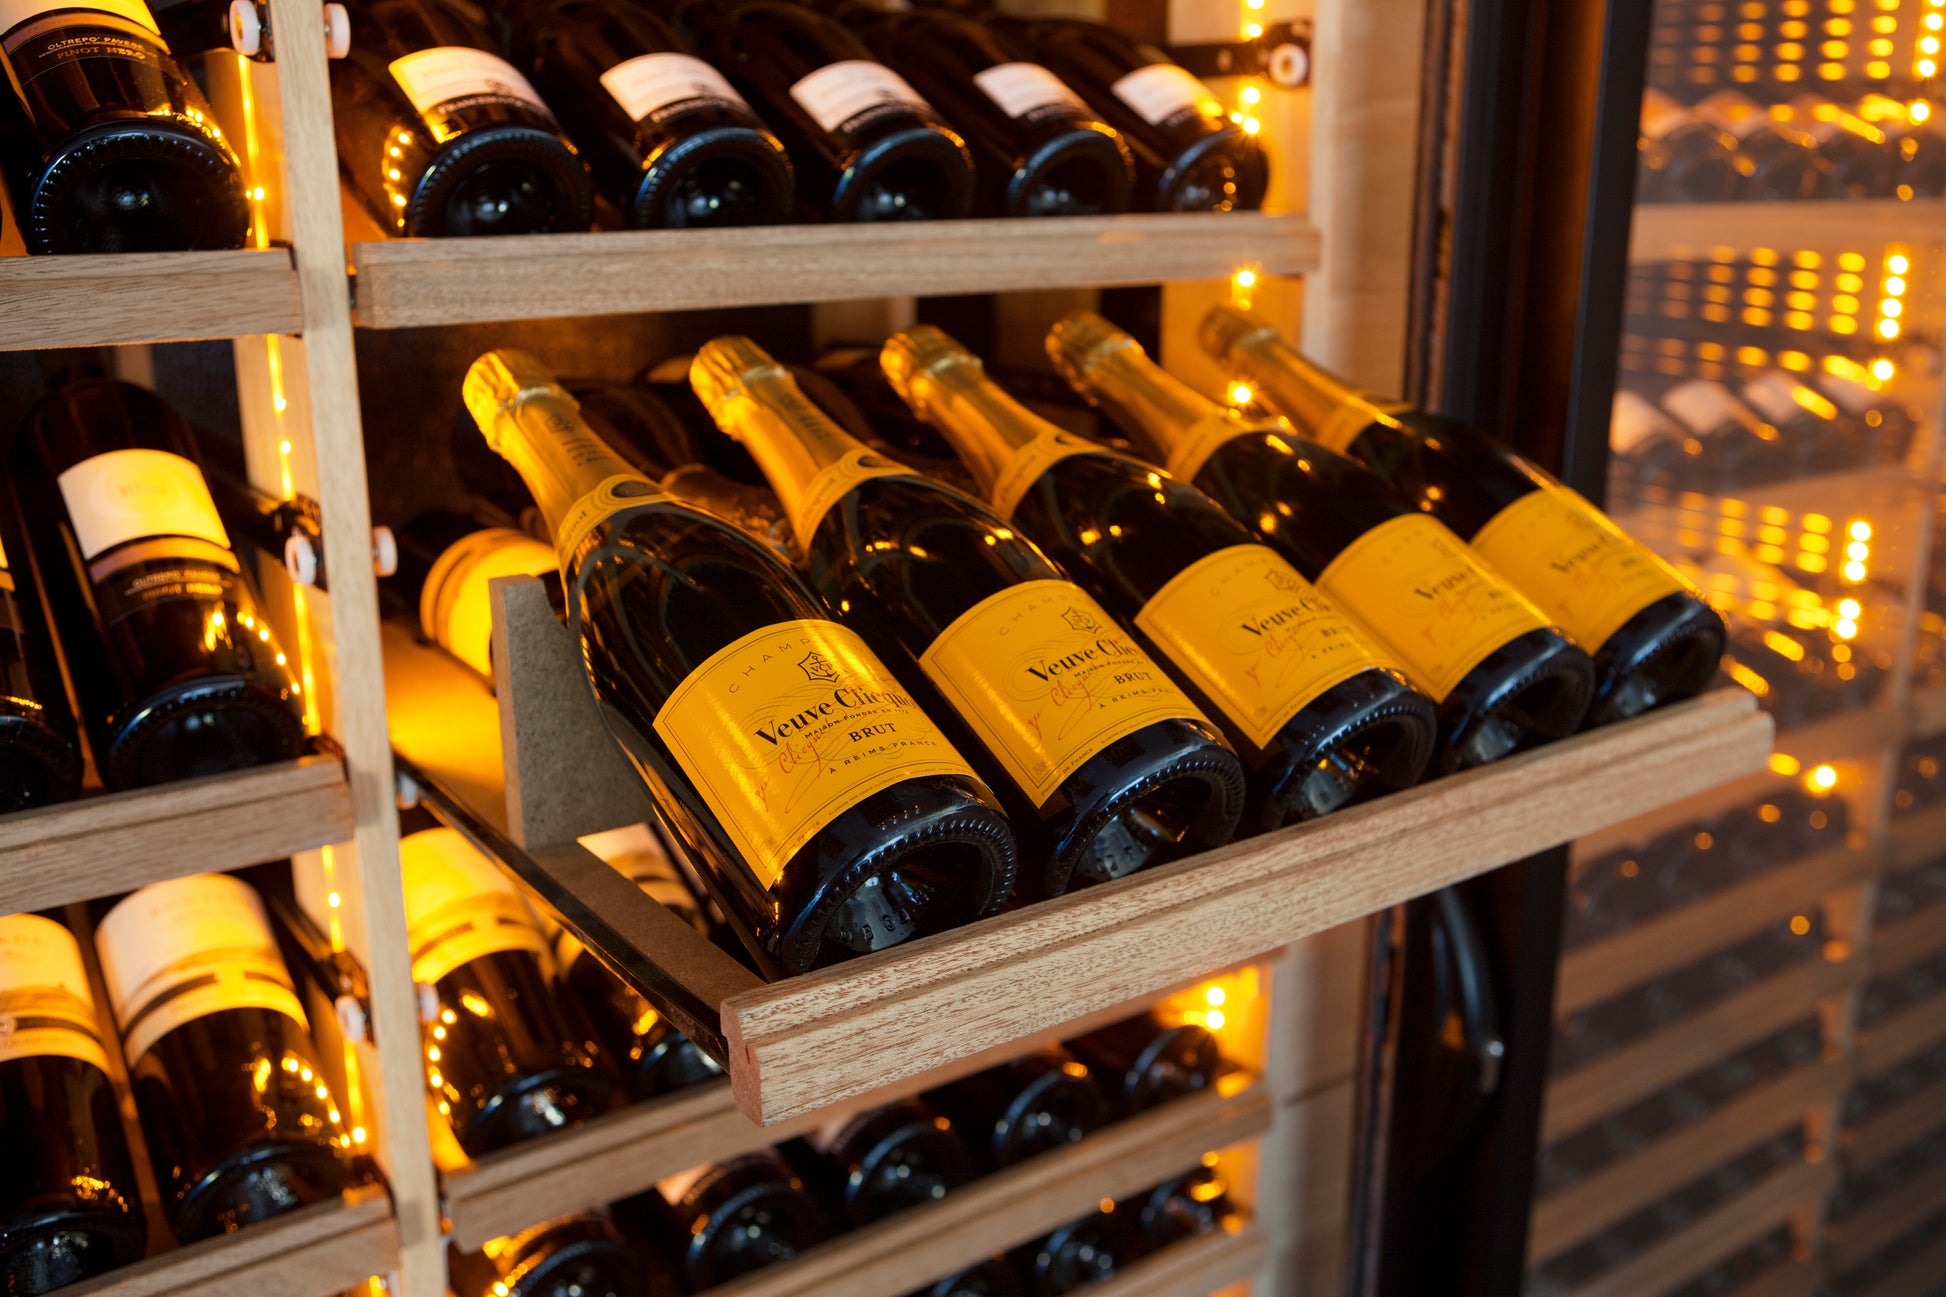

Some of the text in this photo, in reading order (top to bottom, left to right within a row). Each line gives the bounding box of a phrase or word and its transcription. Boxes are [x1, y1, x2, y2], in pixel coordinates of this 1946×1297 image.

[57, 46, 100, 59] PINOT
[106, 46, 146, 60] NERO
[1240, 606, 1300, 636] Veuve
[1024, 648, 1098, 682] Veuve
[1113, 671, 1154, 685] BRUT
[753, 703, 834, 746] Veuve
[804, 718, 840, 740] MAISON
[848, 722, 897, 743] BRUT
[843, 745, 886, 766] REIMS
[892, 740, 937, 748] FRANCE
[1071, 748, 1093, 766] FRANCE
